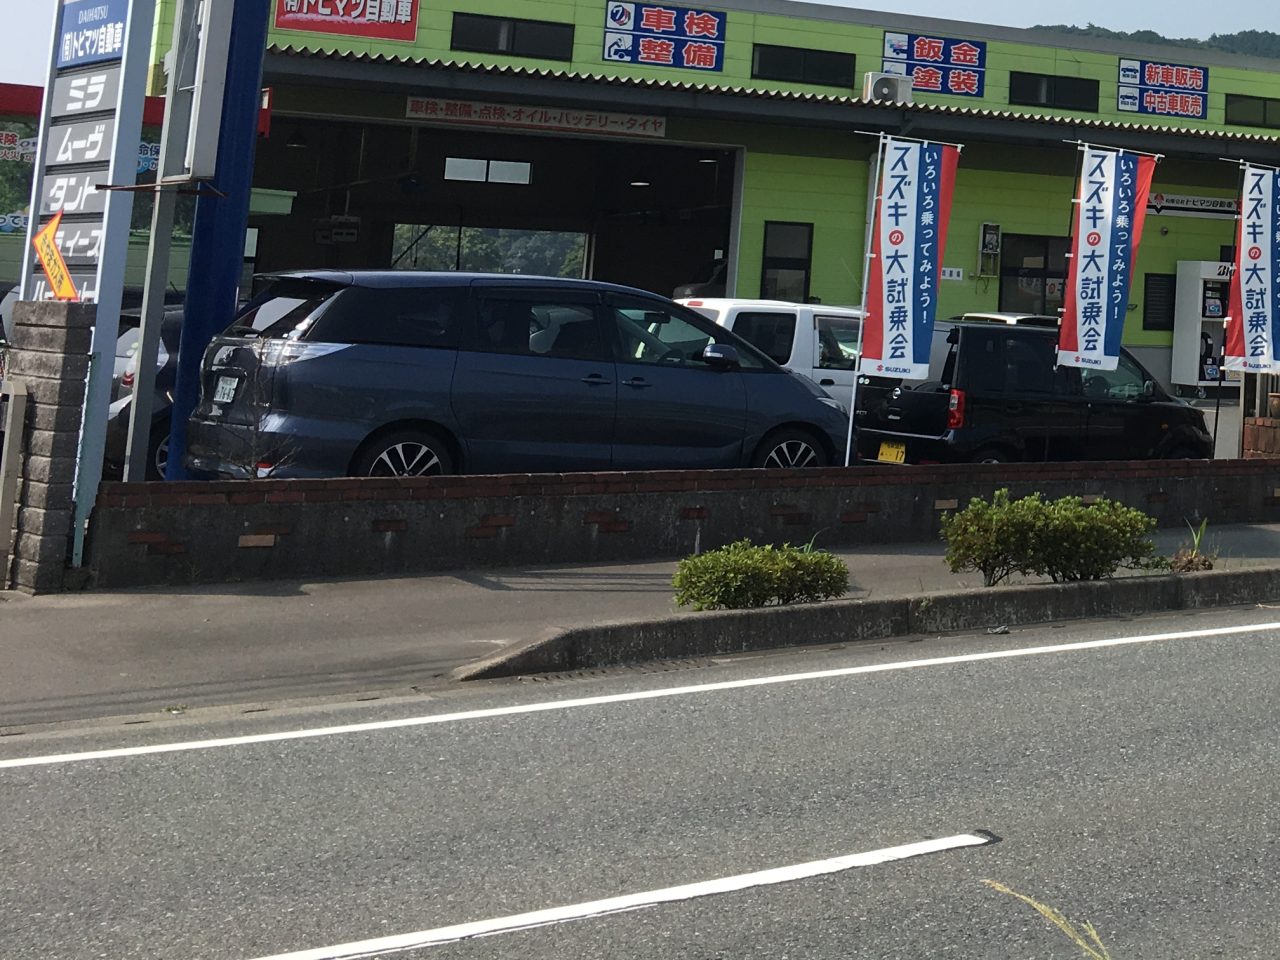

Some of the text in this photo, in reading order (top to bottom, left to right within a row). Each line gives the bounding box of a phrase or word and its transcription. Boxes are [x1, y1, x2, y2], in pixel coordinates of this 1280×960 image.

[78, 5, 109, 24] DAIHATSU
[641, 7, 719, 38] 車検
[639, 38, 717, 68] 整備
[914, 37, 980, 66] 鈑金
[912, 66, 978, 94] 塗装
[1145, 63, 1203, 90] 新車販売
[66, 74, 107, 111] ミラ
[1144, 90, 1202, 117] 中古車販売
[56, 124, 105, 161] ムーヴ
[49, 176, 99, 211] タント
[886, 146, 912, 359] スズキの大試乗会
[1080, 154, 1108, 351] スズキの大試乗会
[1245, 172, 1268, 357] スズキの大試乗会
